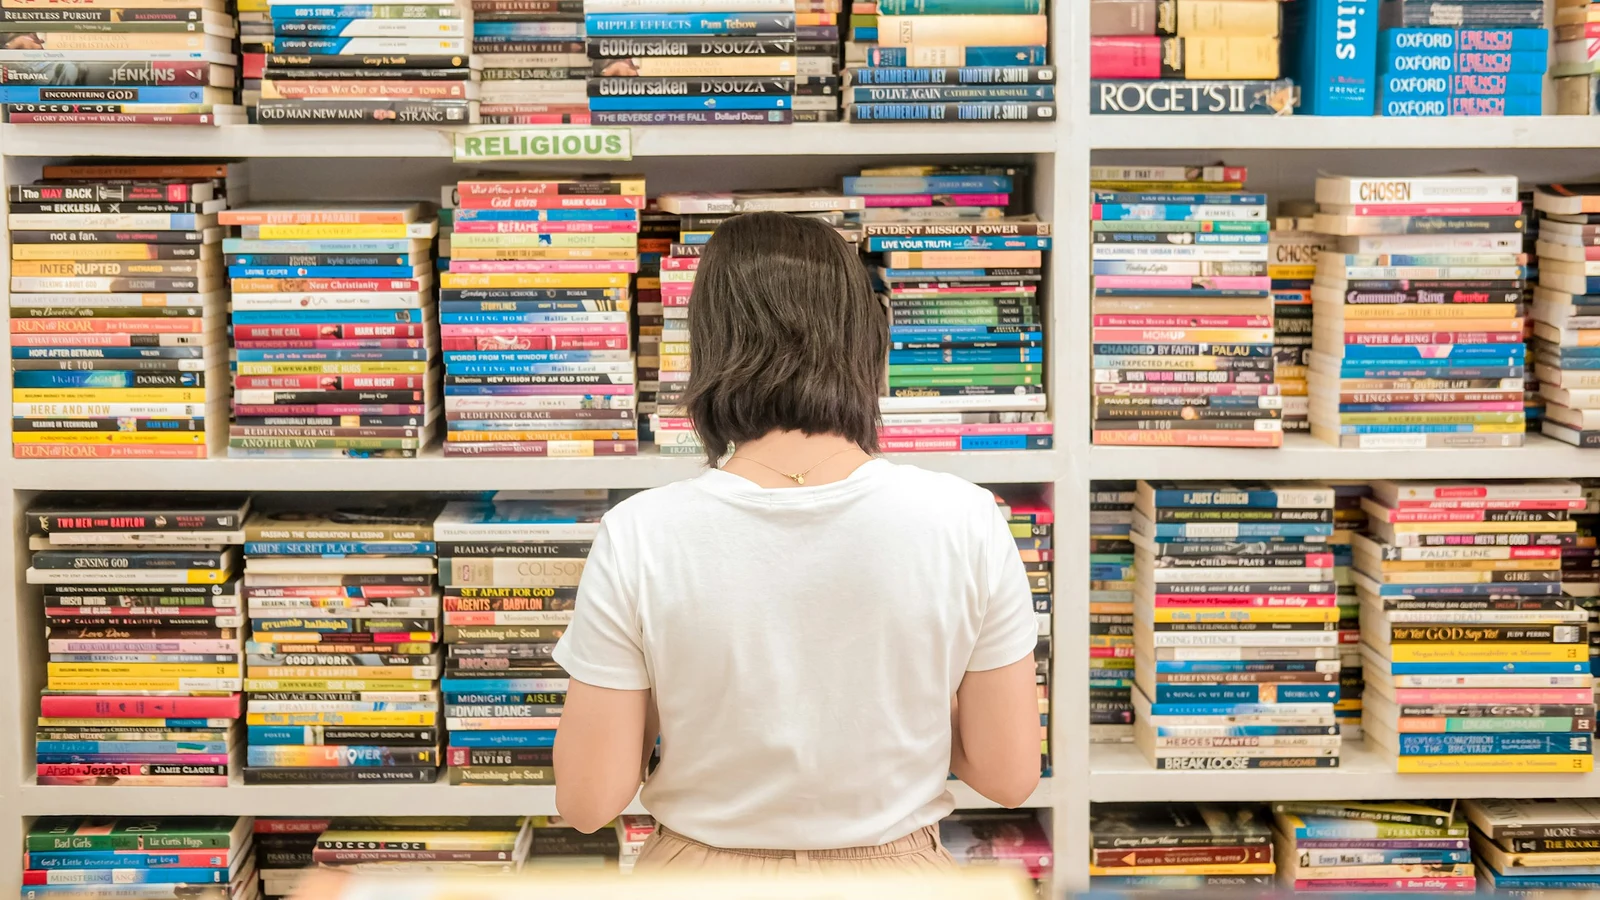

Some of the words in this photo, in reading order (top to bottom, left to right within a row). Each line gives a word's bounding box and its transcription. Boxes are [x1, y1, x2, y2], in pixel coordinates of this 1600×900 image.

[5, 12, 60, 20] RELENTLESS
[63, 12, 102, 20] PURSUIT
[597, 21, 637, 30] RIPPLE
[640, 20, 691, 30] EFFECTS
[724, 19, 757, 28] Tebow
[1397, 33, 1452, 47] OXFORD
[1461, 31, 1512, 50] FRENCH
[600, 40, 688, 56] GODforsaken
[701, 42, 765, 53] D'SOUZA
[1395, 56, 1451, 71] OXFORD
[1460, 53, 1511, 72] FRENCH
[109, 68, 176, 81] JENKINS
[858, 69, 872, 83] THE
[874, 69, 929, 83] CHAMBERLAIN
[932, 69, 946, 83] KEY
[958, 69, 992, 82] TIMOTHY
[995, 69, 1000, 82] P.
[1003, 69, 1028, 82] SMITH
[600, 79, 687, 95] GODforsaken
[701, 81, 765, 92] D'SOUZA
[1390, 78, 1446, 92] OXFORD
[1455, 75, 1506, 94] FRENCH
[45, 91, 105, 99] ENCOUNTERING
[107, 90, 133, 99] GOD
[277, 86, 306, 94] PRAYING
[309, 86, 330, 94] YOUR
[380, 86, 412, 94] BONDAGE
[870, 89, 883, 99] TO
[886, 88, 909, 99] LIVE
[910, 88, 940, 98] AGAIN
[1100, 83, 1226, 111] ROGET'S
[1229, 85, 1245, 111] II
[858, 106, 871, 119] THE
[874, 106, 928, 119] CHAMBERLAIN
[931, 106, 945, 119] KEY
[958, 106, 992, 119] TIMOTHY
[994, 106, 1000, 119] P.
[1003, 106, 1028, 119] SMITH
[1389, 101, 1444, 115] OXFORD
[263, 109, 285, 119] OLD
[286, 109, 311, 118] MAN
[314, 109, 336, 118] NEW
[338, 109, 362, 118] MAN
[400, 111, 443, 121] STRANG
[598, 114, 615, 122] THE
[617, 114, 653, 122] REVERSE
[655, 114, 666, 122] OF
[715, 112, 740, 120] Dollard
[465, 135, 621, 156] RELIGIOUS
[23, 190, 39, 198] The
[41, 189, 63, 198] WAY
[65, 189, 92, 198] BACK
[1360, 182, 1411, 200] CHOSEN
[491, 197, 510, 207] God
[868, 226, 922, 234] STUDENT
[925, 226, 972, 234] MISSION
[976, 225, 1018, 233] POWER
[51, 232, 67, 241] not
[79, 232, 97, 240] fan.
[40, 264, 120, 274] INTERRUPTED
[331, 280, 379, 291] Christianity
[1143, 331, 1185, 340] MOMUP
[1357, 335, 1389, 343] ENTER
[1391, 335, 1403, 343] the
[1404, 335, 1429, 343] RING
[1100, 345, 1154, 354] CHANGED
[1158, 346, 1169, 354] BY
[1171, 346, 1195, 355] FAITH
[1212, 346, 1249, 355] PALAU
[31, 406, 57, 414] HERE
[63, 406, 83, 414] AND
[88, 405, 110, 414] NOW
[242, 440, 291, 448] ANOTHER
[58, 519, 73, 527] TWO
[75, 519, 92, 527] MEN
[110, 518, 145, 527] BABYLON
[1420, 550, 1457, 558] FAULT
[74, 558, 109, 568] SENSING
[111, 559, 128, 567] GOD
[1504, 573, 1530, 581] GIRE
[461, 588, 477, 596] SET
[480, 588, 509, 596] APART
[513, 588, 531, 596] FOR
[533, 588, 554, 596] GOD
[458, 629, 504, 640] Nourishing
[507, 630, 518, 638] the
[520, 629, 539, 638] Seed
[1426, 628, 1463, 641] GOD
[286, 656, 314, 665] GOOD
[317, 656, 349, 665] WORK
[458, 695, 506, 703] MIDNIGHT
[526, 695, 556, 703] AISLE
[456, 706, 491, 716] DIVINE
[495, 706, 531, 716] DANCE
[1213, 738, 1258, 746] WANTED
[1165, 758, 1206, 769] BREAK
[1207, 758, 1249, 769] LOOSE
[46, 766, 75, 776] Ahab
[83, 766, 131, 775] Jezebel
[463, 771, 508, 781] Nourishing
[510, 771, 522, 779] the
[525, 770, 543, 779] Seed
[54, 839, 70, 848] Bad
[73, 838, 92, 848] Girls
[150, 837, 160, 846] Liz
[162, 836, 181, 846] Curtis
[183, 836, 203, 846] Higgs
